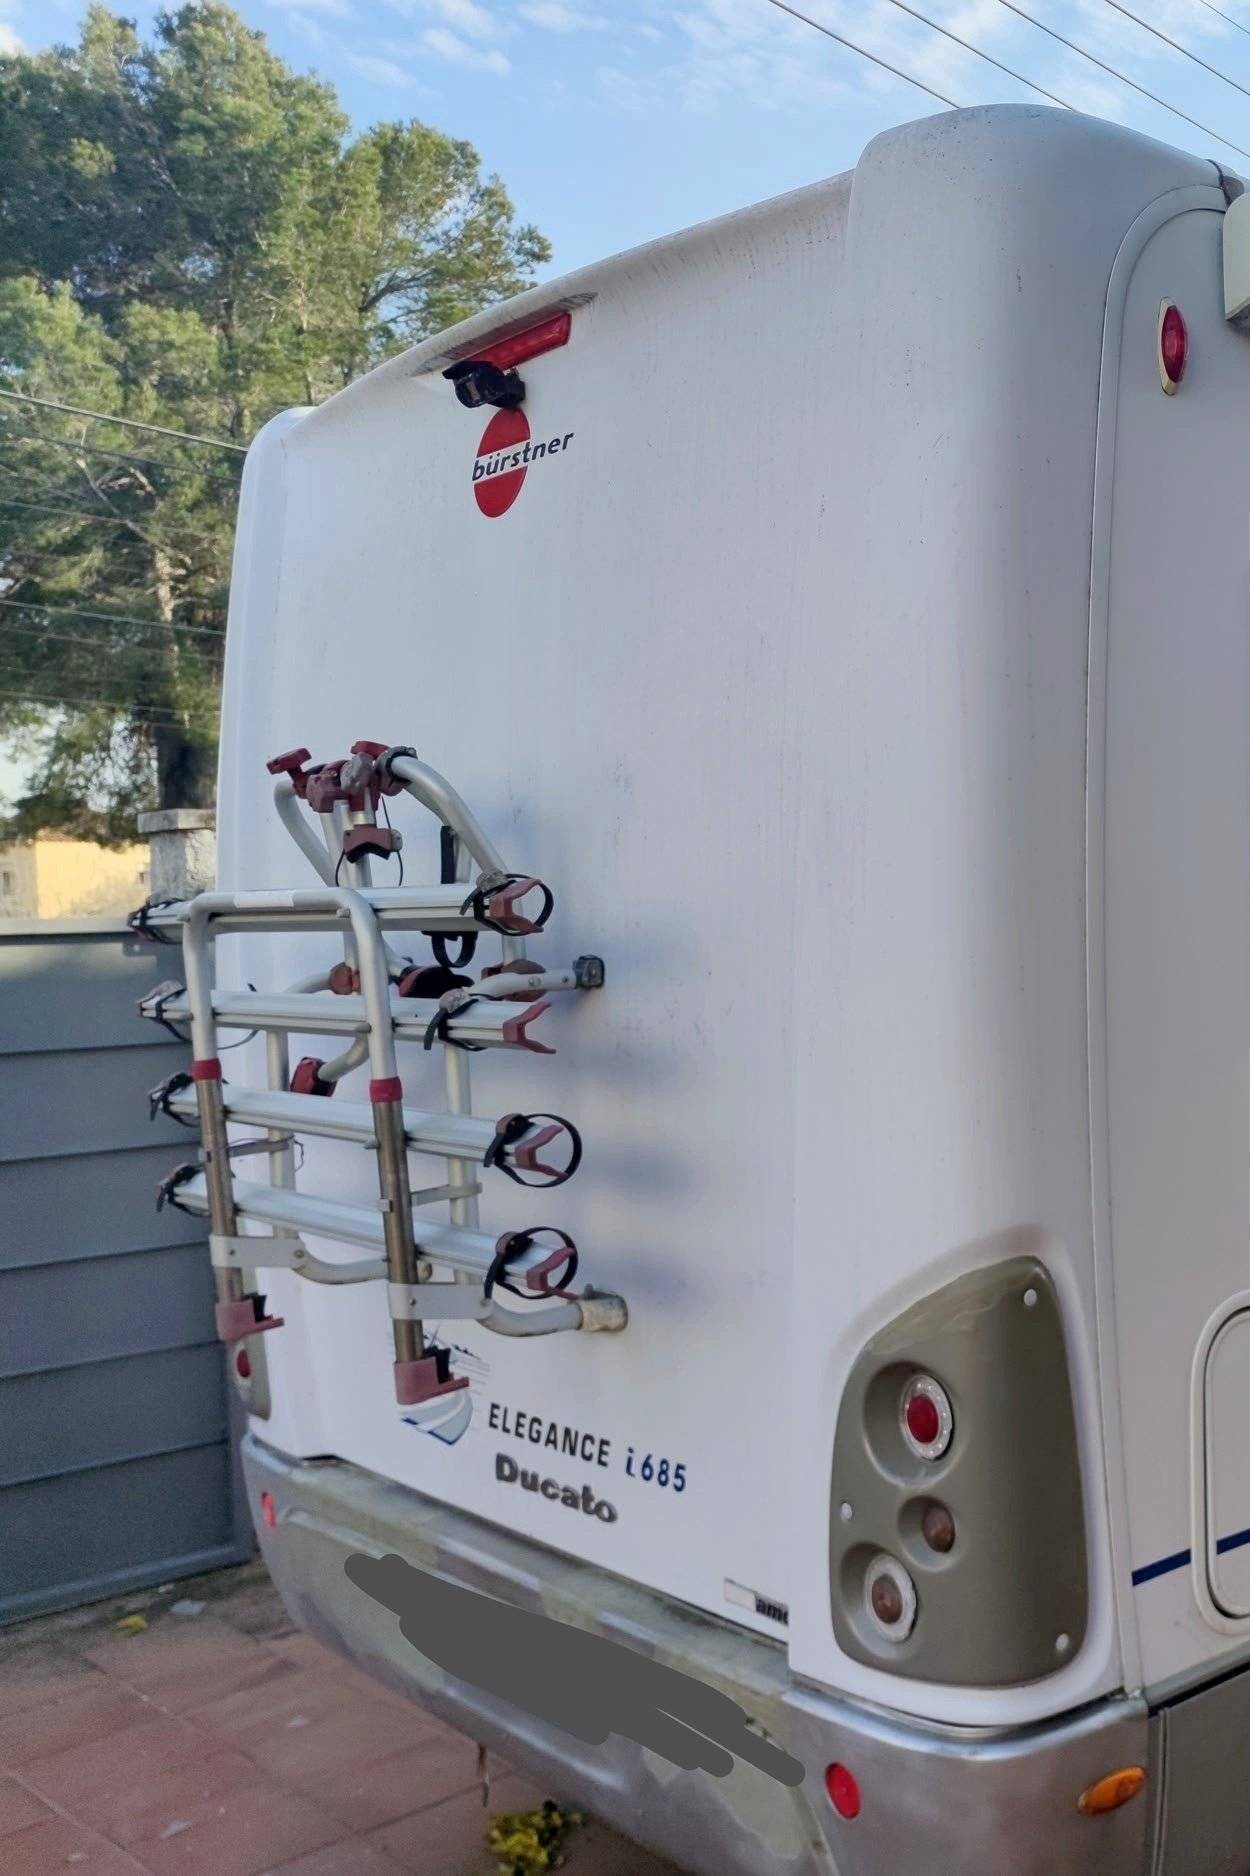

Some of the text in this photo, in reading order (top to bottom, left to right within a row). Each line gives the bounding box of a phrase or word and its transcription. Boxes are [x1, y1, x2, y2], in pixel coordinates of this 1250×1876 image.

[472, 432, 574, 481] bürstner
[488, 1402, 611, 1467] ELEGANCE
[495, 1452, 618, 1523] Ducato
